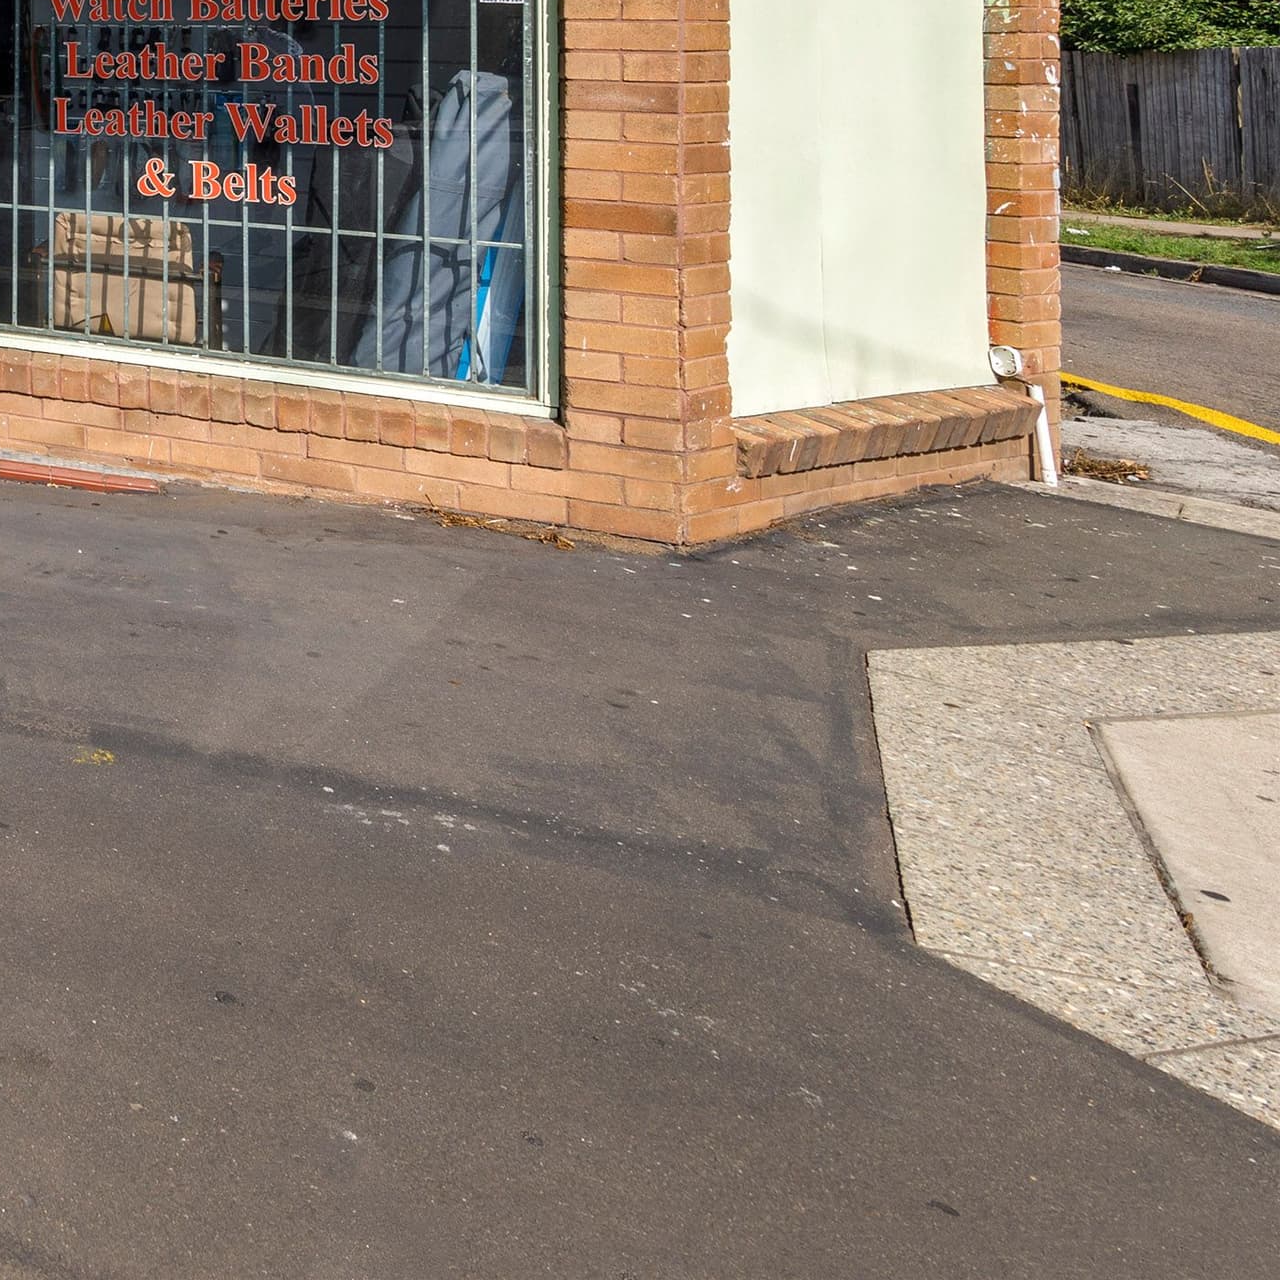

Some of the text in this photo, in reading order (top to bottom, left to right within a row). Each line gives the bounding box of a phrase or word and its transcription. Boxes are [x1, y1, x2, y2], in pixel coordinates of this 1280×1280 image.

[64, 41, 379, 85] Leather Bands
[53, 97, 394, 149] Leather Wallets
[137, 157, 297, 205] & Belts
